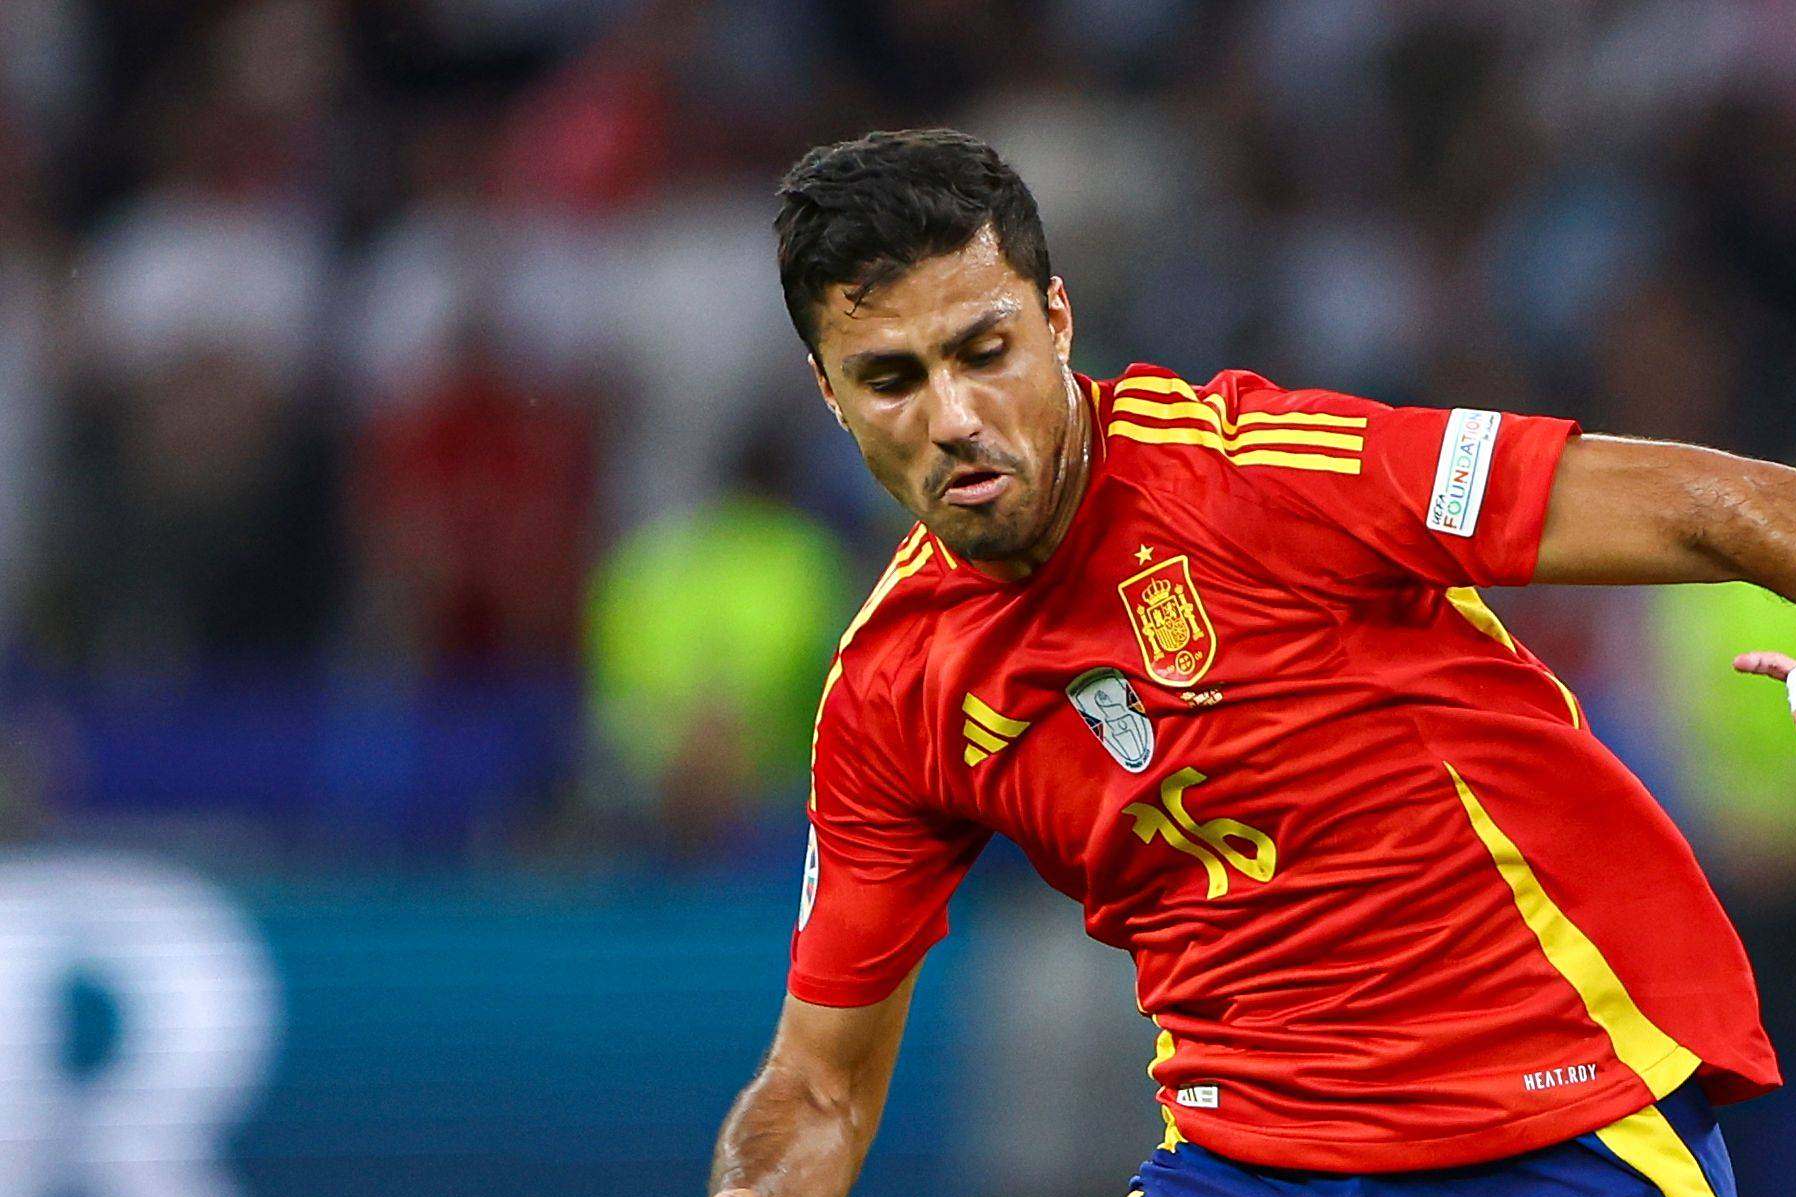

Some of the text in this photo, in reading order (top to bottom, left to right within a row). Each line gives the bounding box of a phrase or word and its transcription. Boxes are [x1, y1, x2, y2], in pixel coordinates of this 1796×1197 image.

[1443, 411, 1482, 529] FOUNDATION
[1121, 766, 1277, 900] 16
[1523, 1064, 1597, 1091] HEAT.RDY
